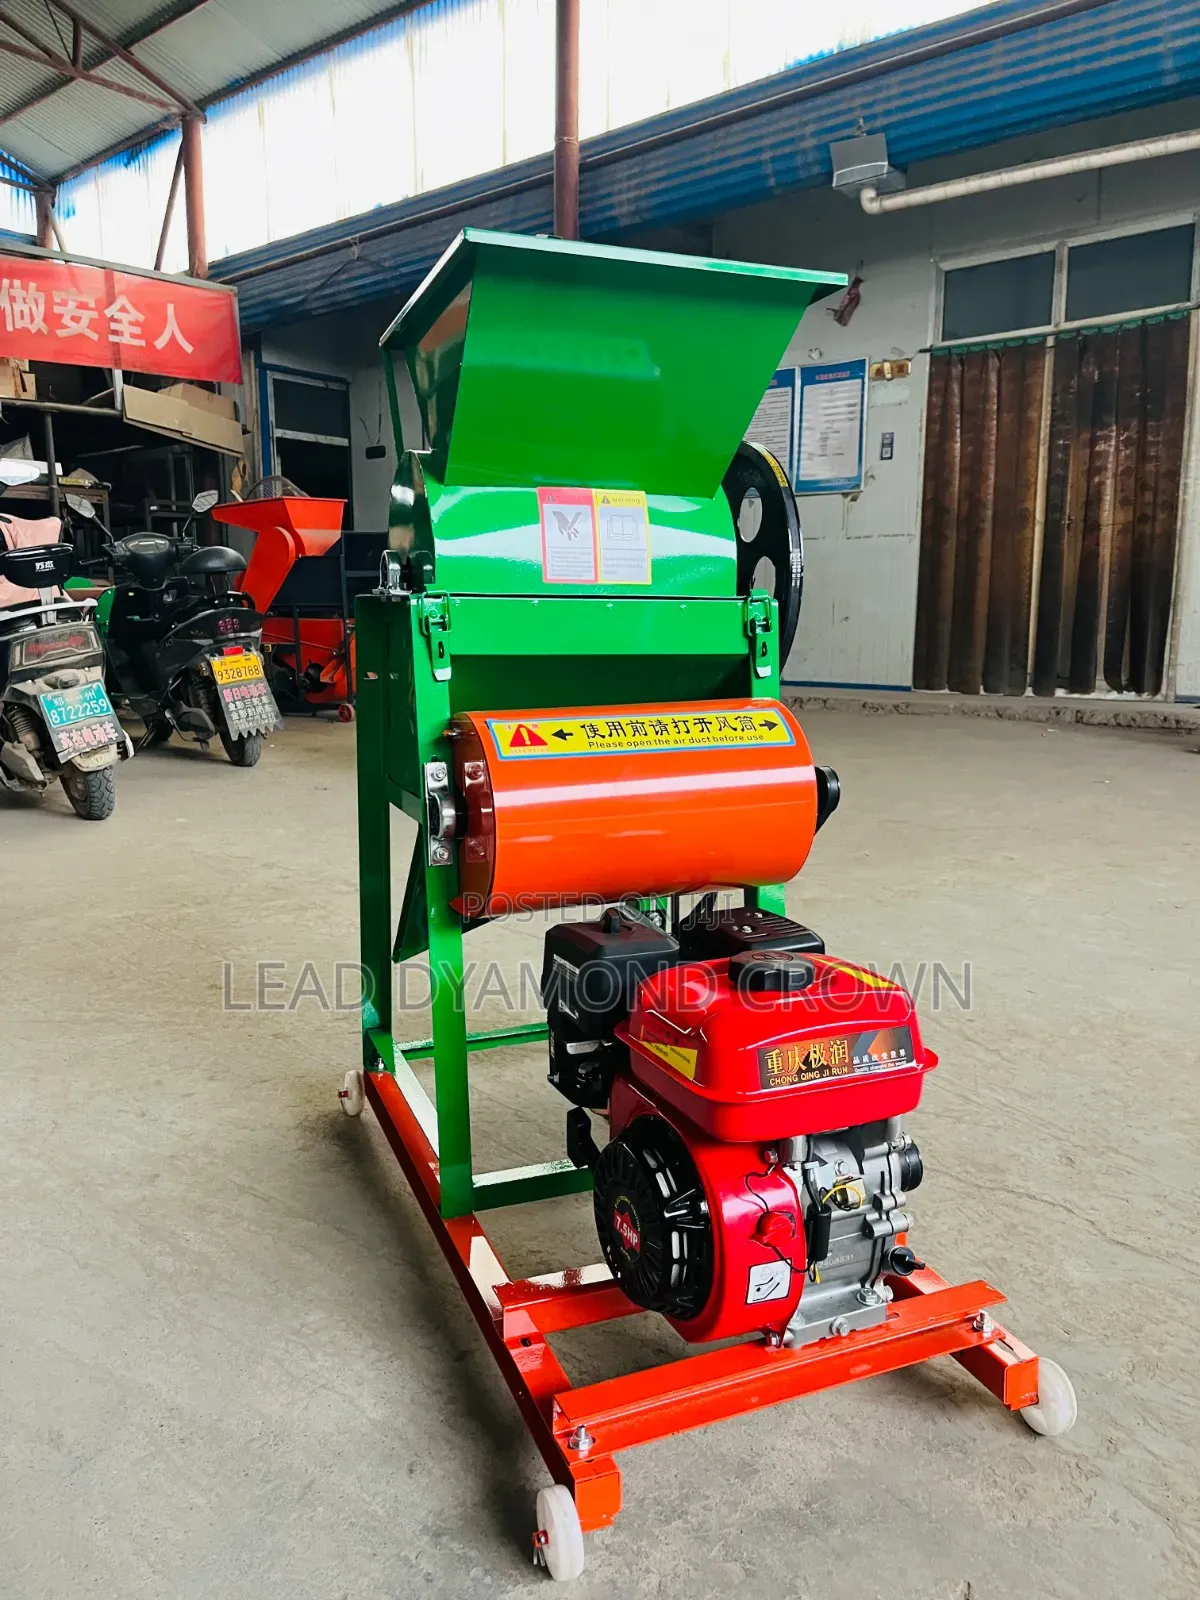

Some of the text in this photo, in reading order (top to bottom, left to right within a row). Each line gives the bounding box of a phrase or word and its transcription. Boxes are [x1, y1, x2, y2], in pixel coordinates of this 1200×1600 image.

[0, 278, 195, 354] 做安全人
[217, 665, 260, 680] 9328788
[50, 698, 107, 723] 8722259
[580, 715, 757, 740] 使用前请打开风筒
[588, 741, 623, 749] Please
[626, 740, 652, 748] open
[689, 736, 710, 744] duct
[713, 735, 743, 743] before
[765, 1039, 849, 1076] 重庆极润
[769, 1066, 848, 1086] CHONG QING JI RUN
[616, 1215, 638, 1246] 7.5HP
